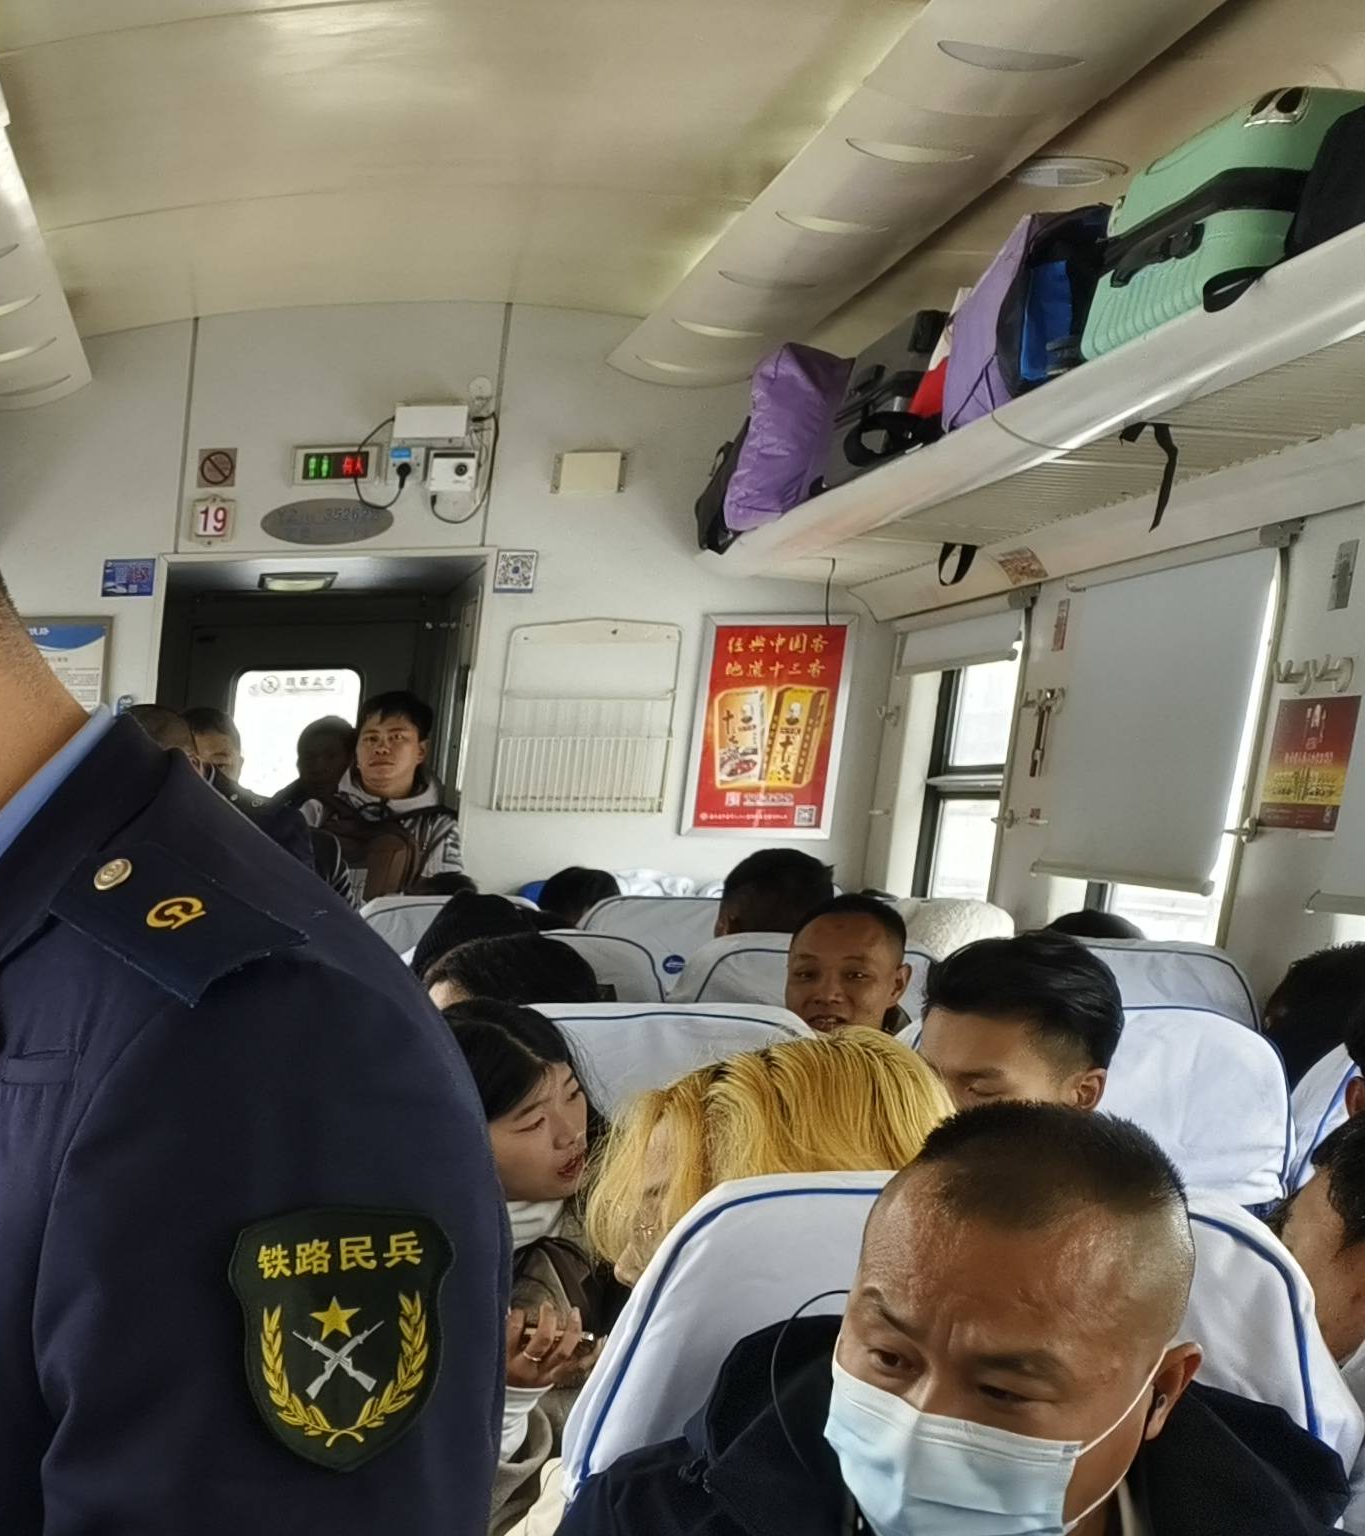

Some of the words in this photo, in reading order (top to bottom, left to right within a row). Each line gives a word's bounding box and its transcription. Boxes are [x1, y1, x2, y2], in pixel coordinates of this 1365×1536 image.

[200, 506, 227, 532] 19
[257, 1231, 424, 1280] 铁路民兵
